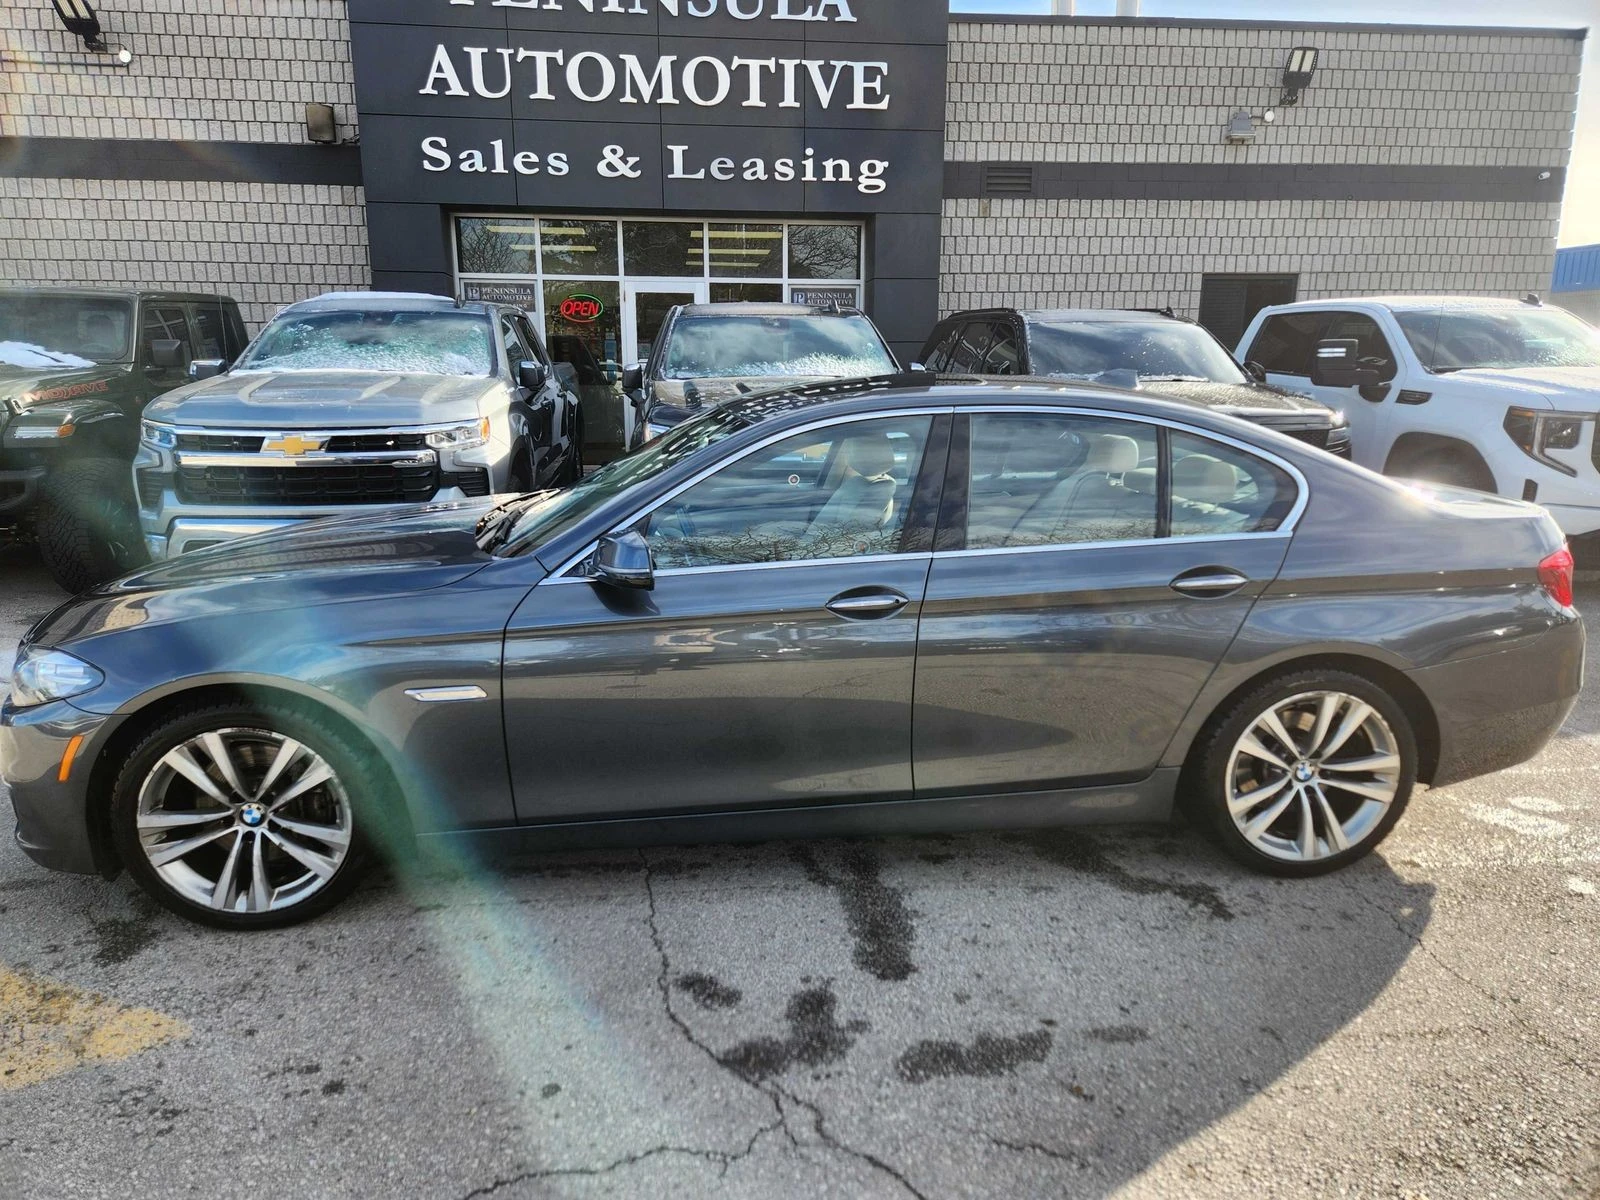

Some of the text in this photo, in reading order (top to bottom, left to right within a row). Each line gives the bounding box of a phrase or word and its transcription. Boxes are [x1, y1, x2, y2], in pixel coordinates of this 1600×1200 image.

[419, 43, 890, 110] AUTOMOTIVE
[421, 136, 889, 193] Sales & Leasing
[482, 287, 531, 295] PENINSULA
[563, 301, 600, 316] OPEN
